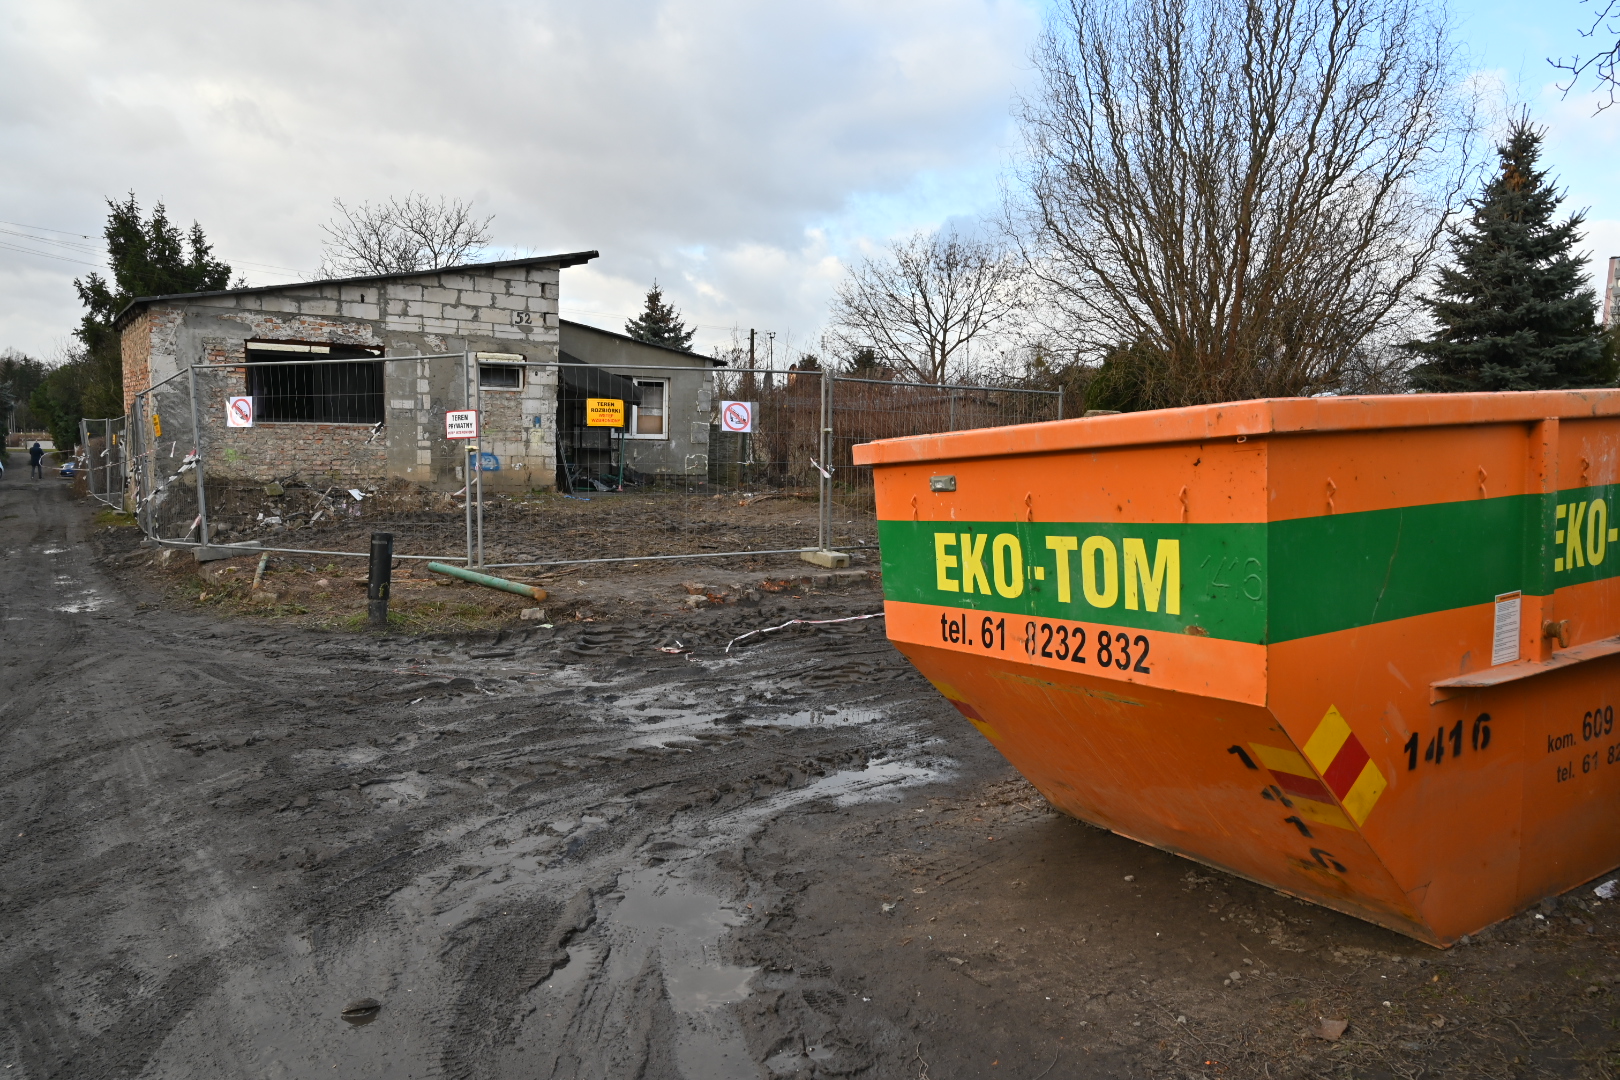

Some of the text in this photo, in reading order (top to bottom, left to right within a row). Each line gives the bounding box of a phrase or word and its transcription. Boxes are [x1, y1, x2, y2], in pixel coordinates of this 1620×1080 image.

[515, 311, 533, 325] 52
[451, 414, 474, 422] TEREN
[933, 532, 1181, 616] EKO-TOM
[940, 612, 1151, 675] tel. 61 8232 832
[1403, 712, 1492, 771] 1416
[1547, 705, 1614, 754] kom. 609
[1556, 761, 1576, 783] tel.
[1582, 751, 1598, 774] 61
